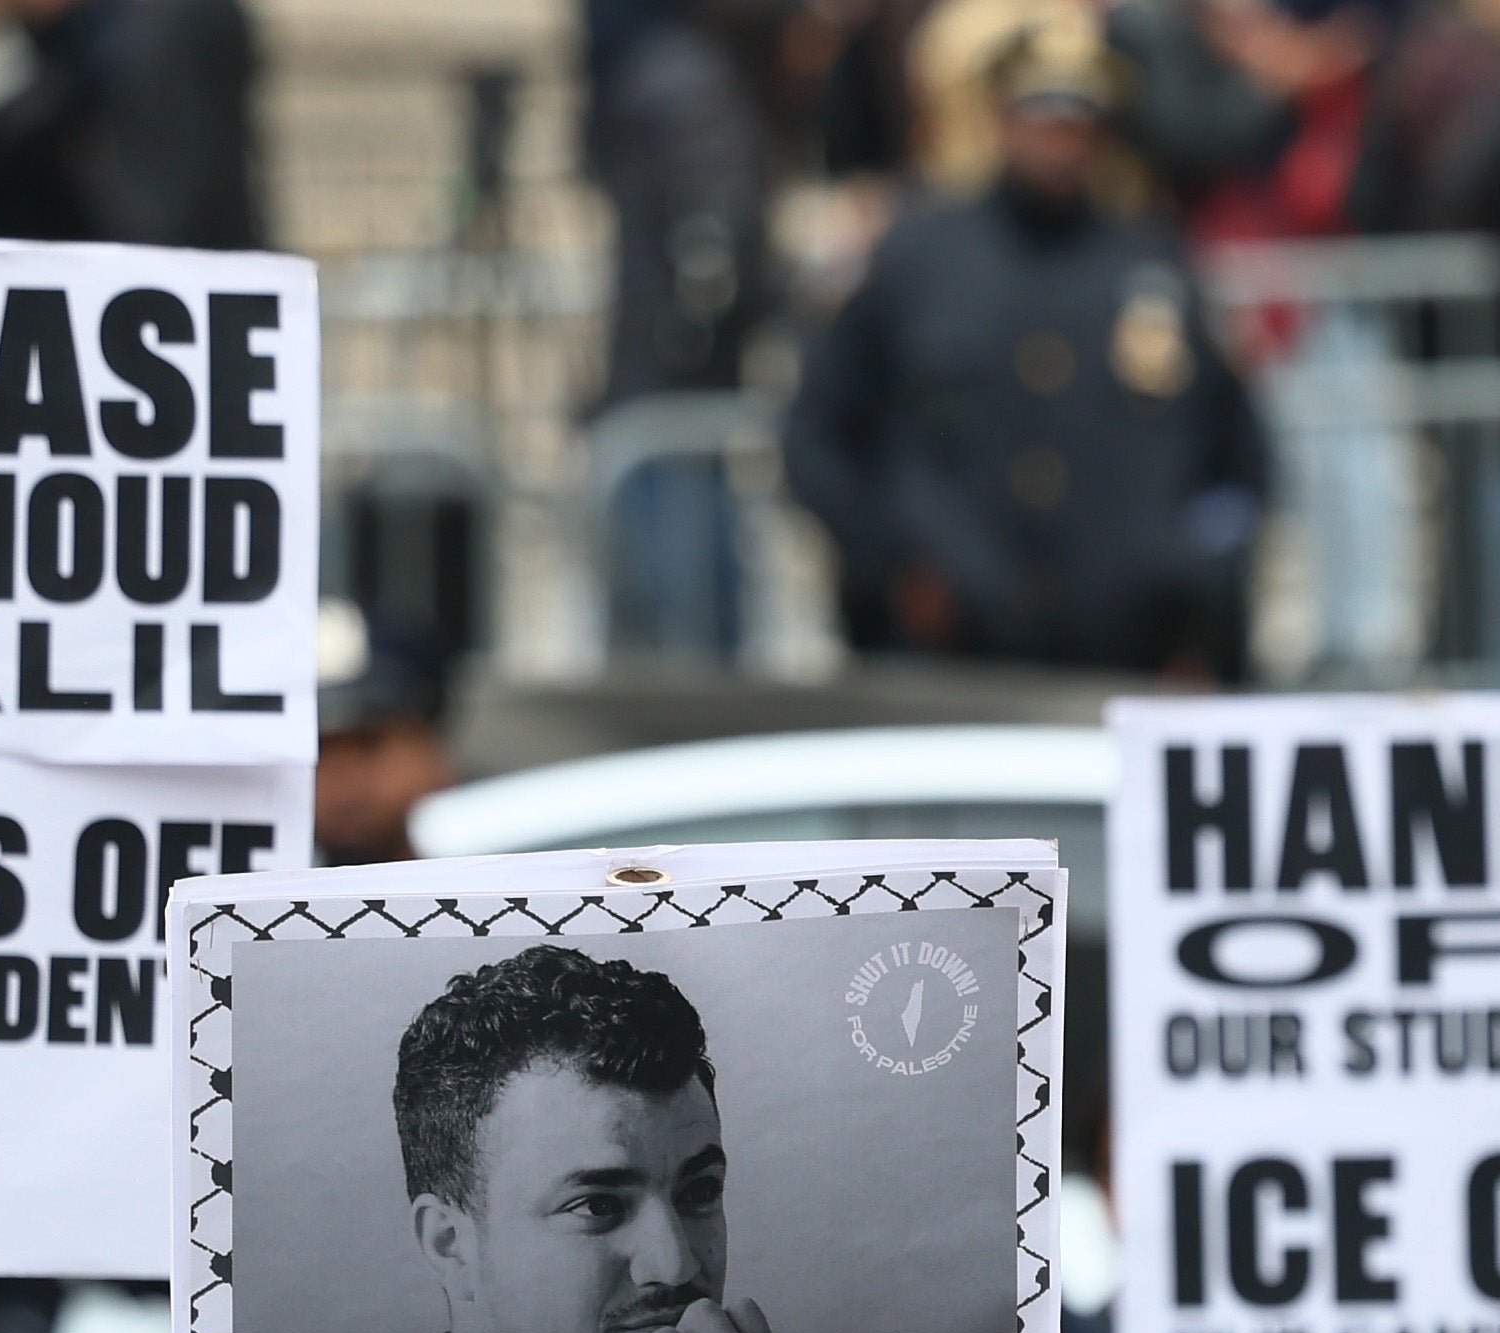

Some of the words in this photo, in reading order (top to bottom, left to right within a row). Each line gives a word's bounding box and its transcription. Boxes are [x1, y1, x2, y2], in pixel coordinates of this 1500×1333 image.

[844, 952, 889, 1006] SHUT
[891, 942, 911, 967] IT
[918, 941, 980, 997] DOWN!
[847, 1015, 877, 1062] FOR
[876, 1004, 978, 1075] PALESTINE
[1163, 1009, 1307, 1081] OUR
[1168, 1154, 1402, 1311] ICE
